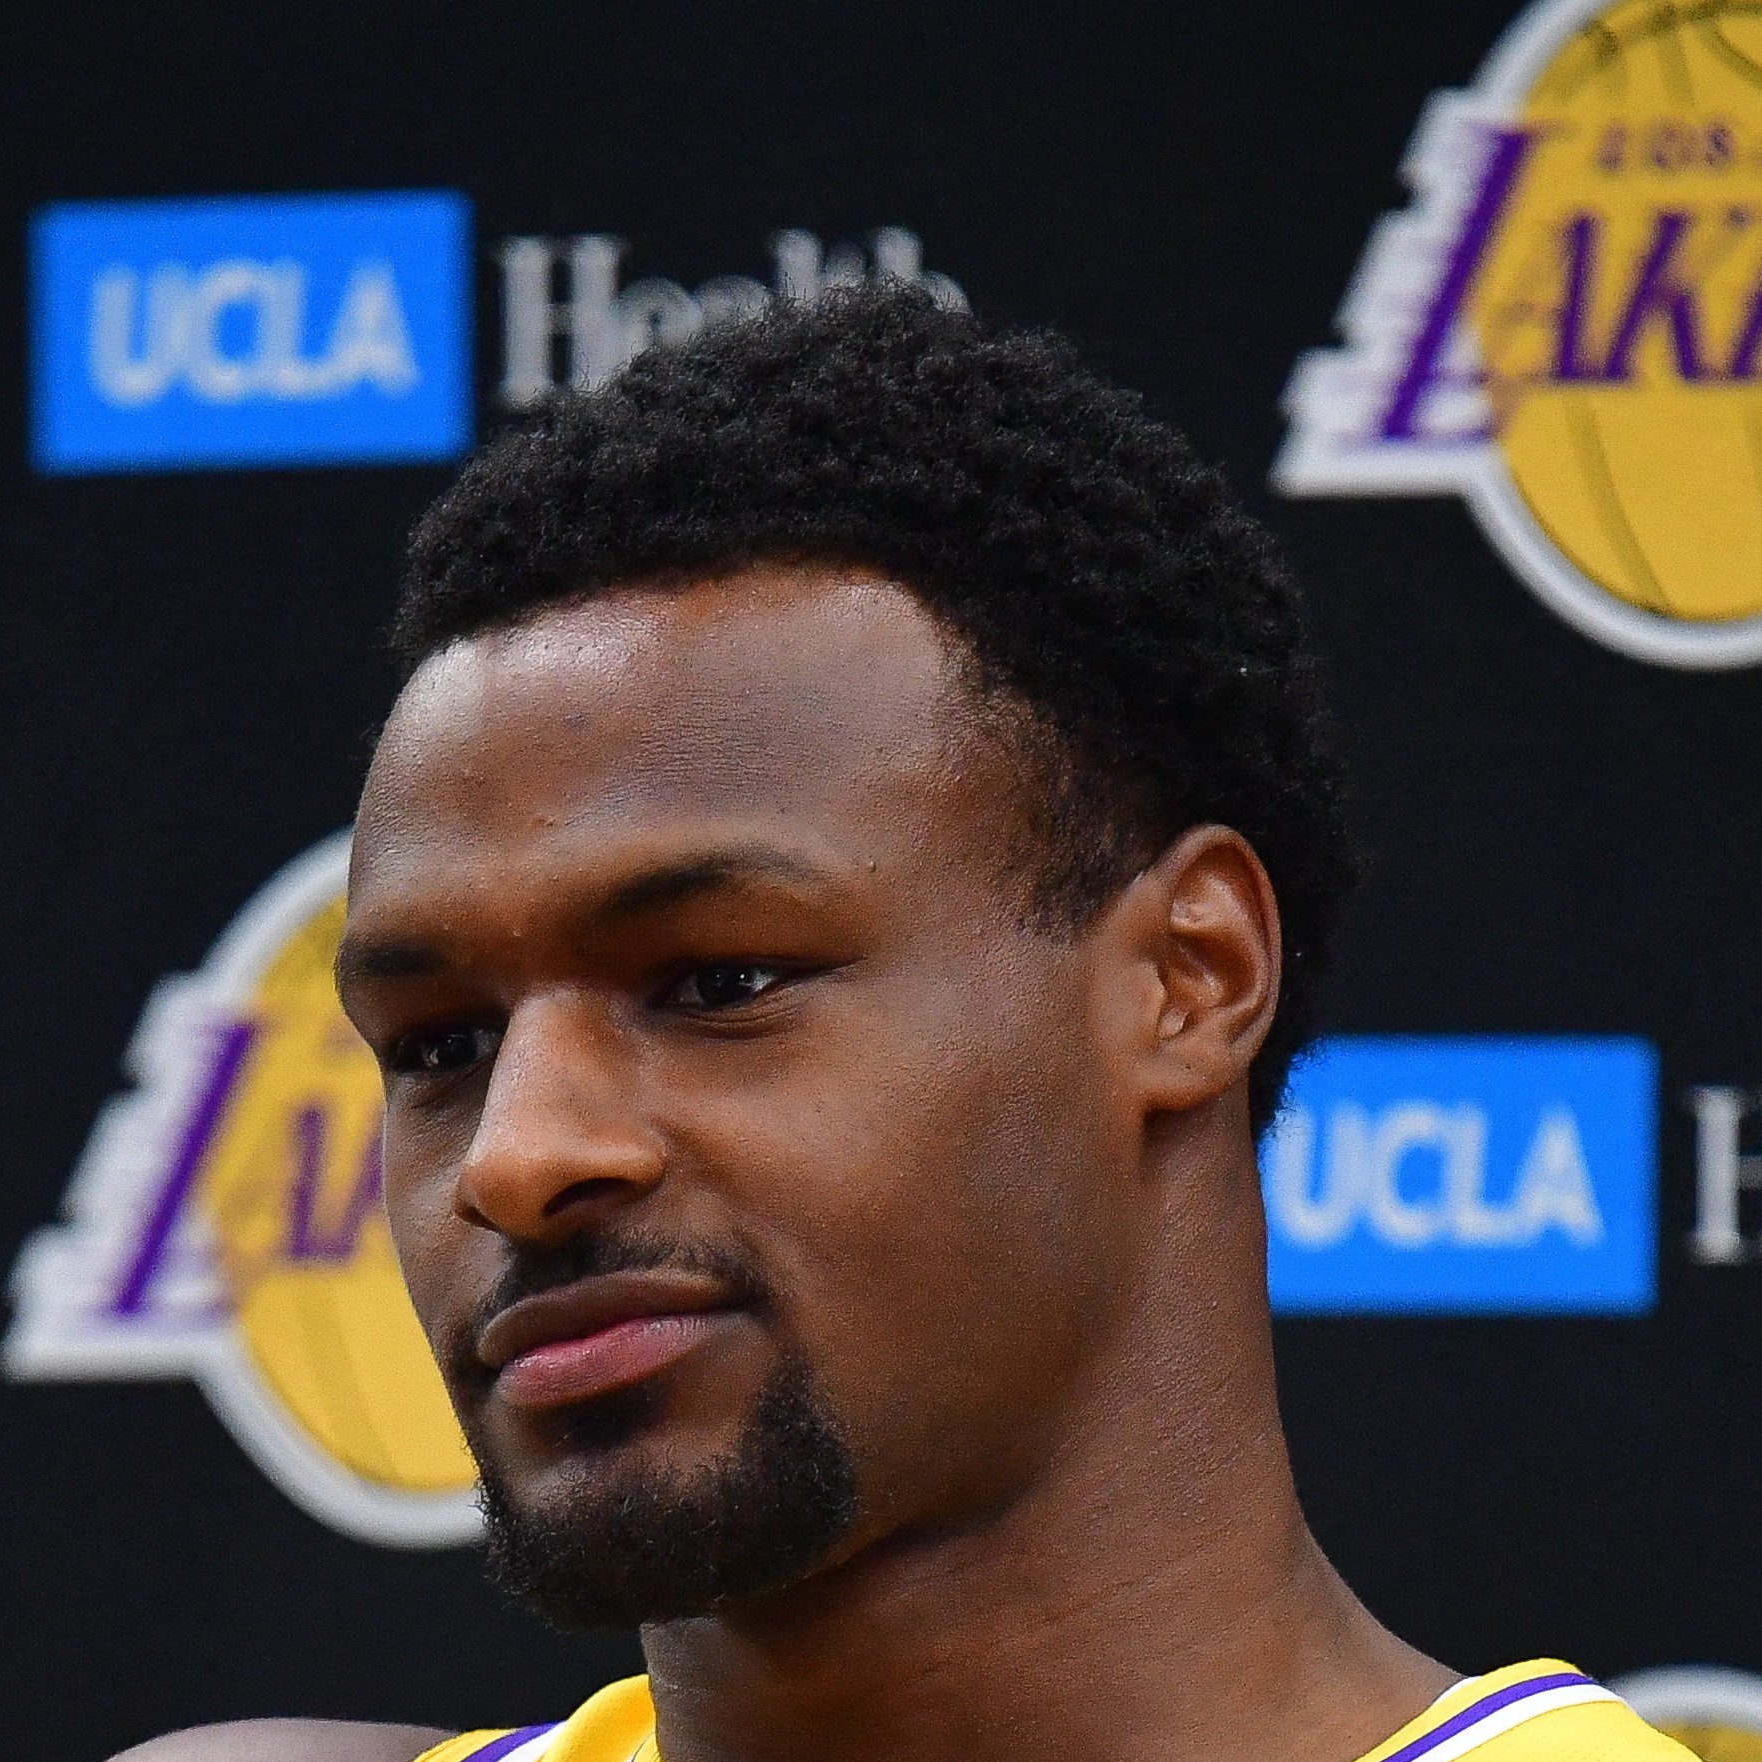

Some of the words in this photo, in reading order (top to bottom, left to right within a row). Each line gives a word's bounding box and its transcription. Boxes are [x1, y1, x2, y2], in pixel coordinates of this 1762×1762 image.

[1594, 120, 1736, 172] LOS
[87, 254, 423, 408] UCLA
[1263, 1098, 1605, 1250] UCLA
